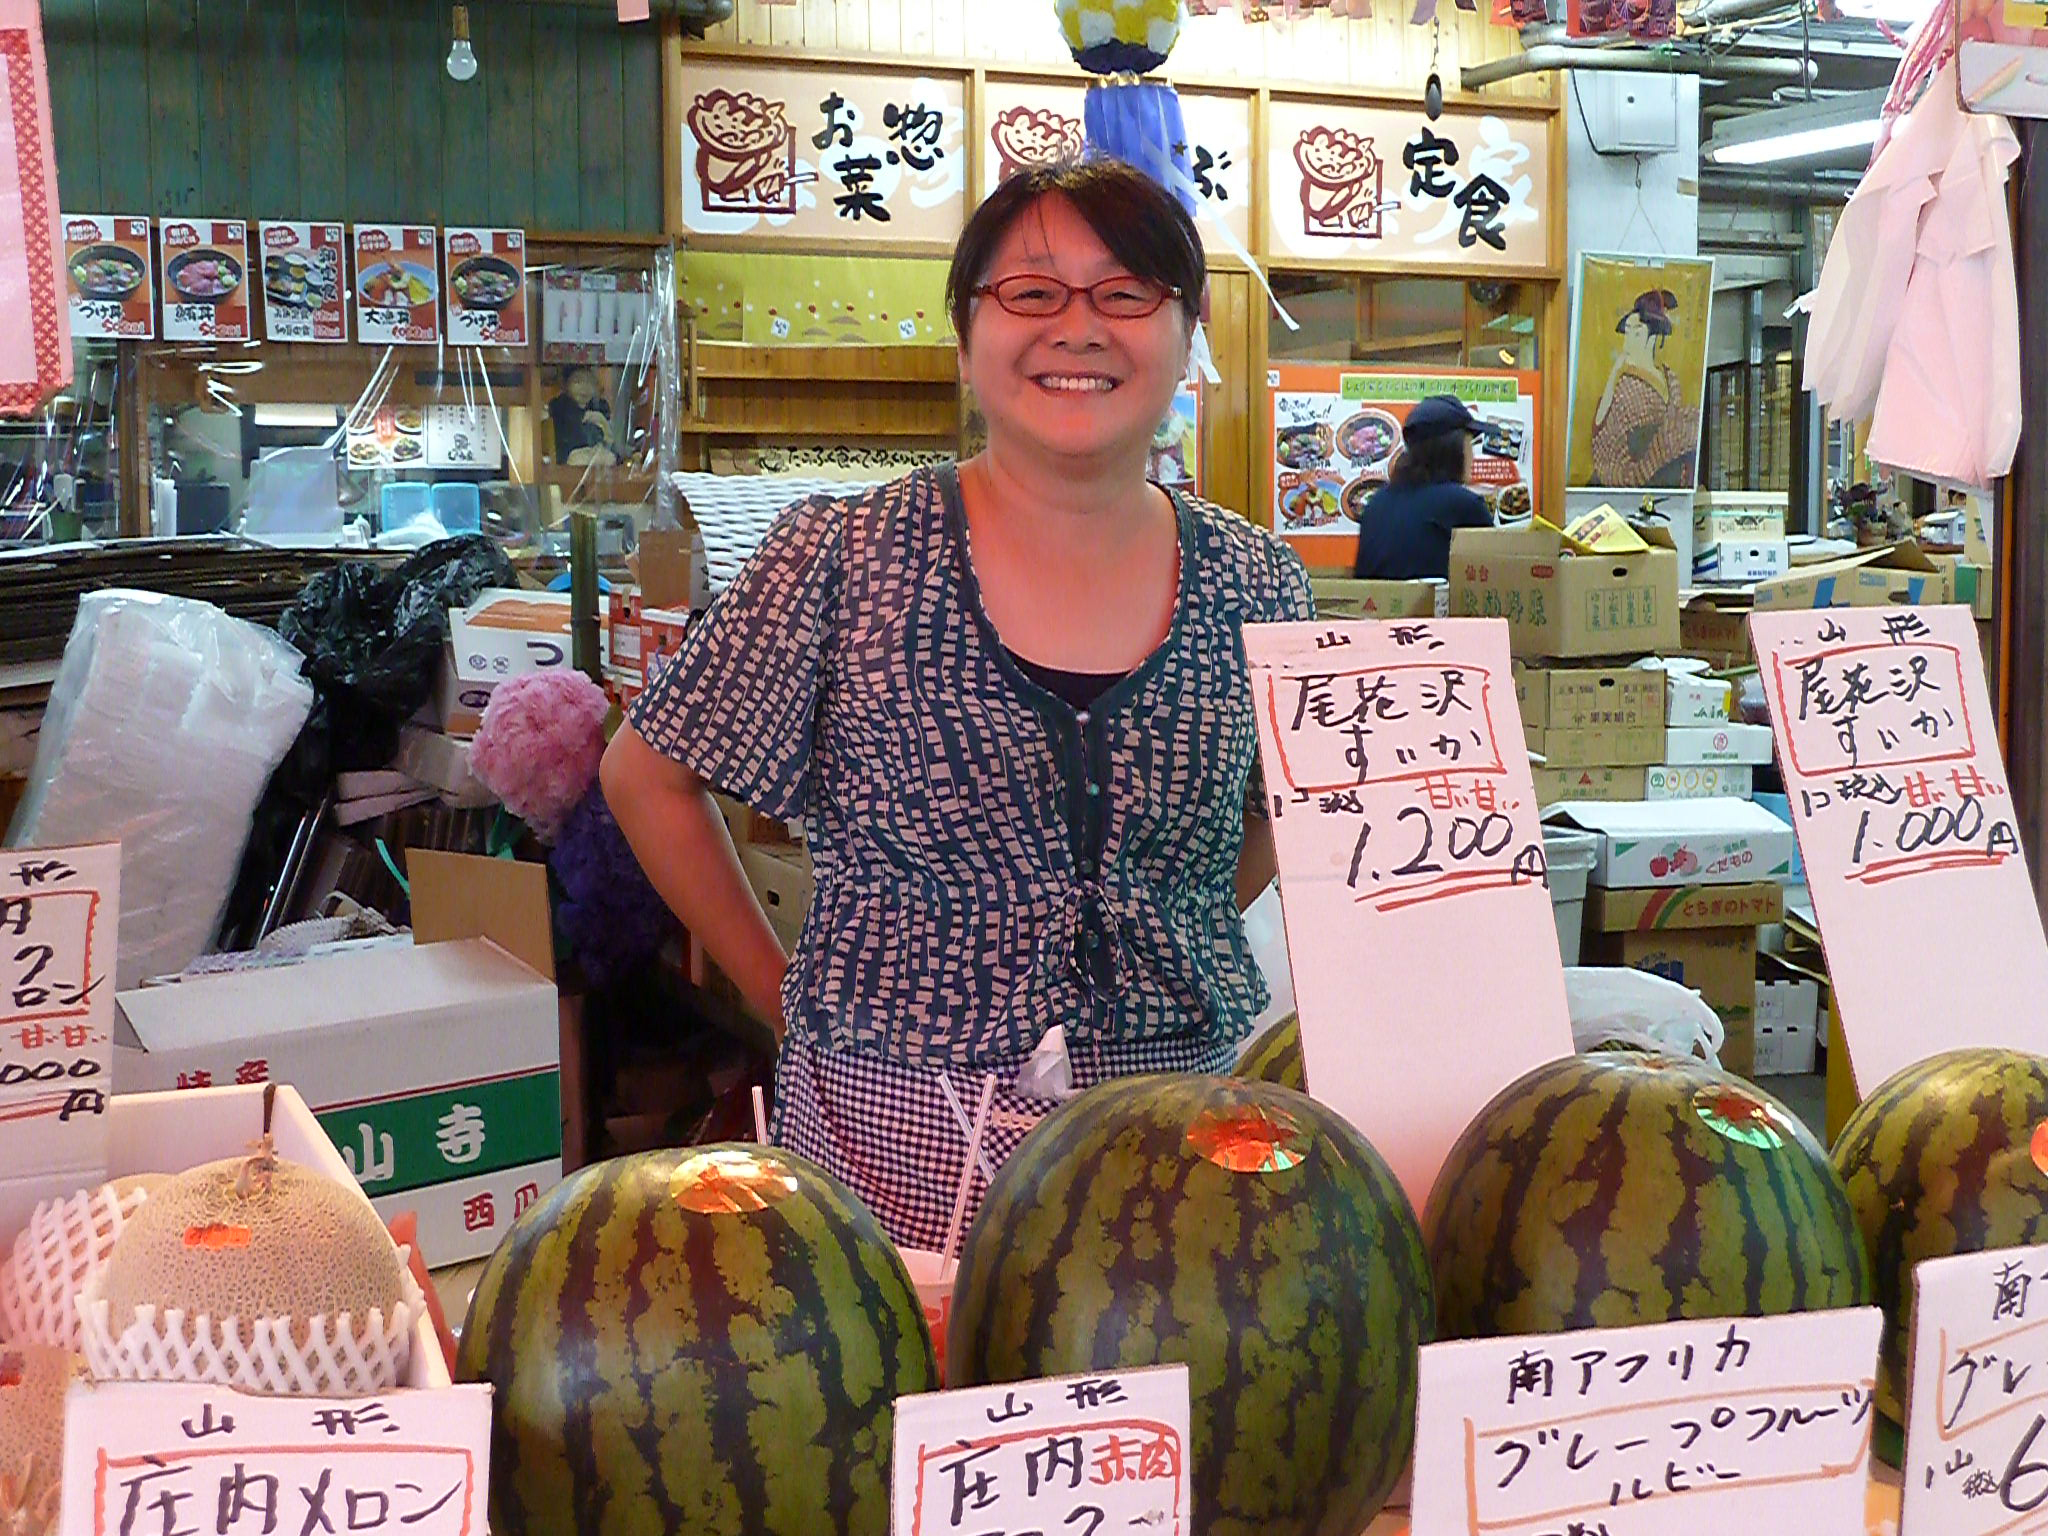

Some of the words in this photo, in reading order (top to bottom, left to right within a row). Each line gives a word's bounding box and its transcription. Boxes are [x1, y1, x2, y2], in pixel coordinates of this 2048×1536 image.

[1402, 127, 1510, 251] 定食
[1315, 630, 1444, 650] 山形
[1817, 613, 1930, 645] 山形
[1291, 670, 1472, 730] 尾花沢
[1796, 655, 1940, 720] 尾花沢
[1340, 723, 1482, 785] すいか
[1832, 707, 1954, 768] すいか
[1705, 850, 1753, 875] くだもの
[343, 1103, 486, 1184] 山寺
[1506, 1324, 1751, 1404] 南アフリカ
[181, 1402, 401, 1439] 山形
[986, 1379, 1129, 1423] 山形
[1494, 1387, 1873, 1489] グレープフルーツ
[115, 1455, 463, 1536] 庄内メロン
[1610, 1461, 1742, 1507] ルビー
